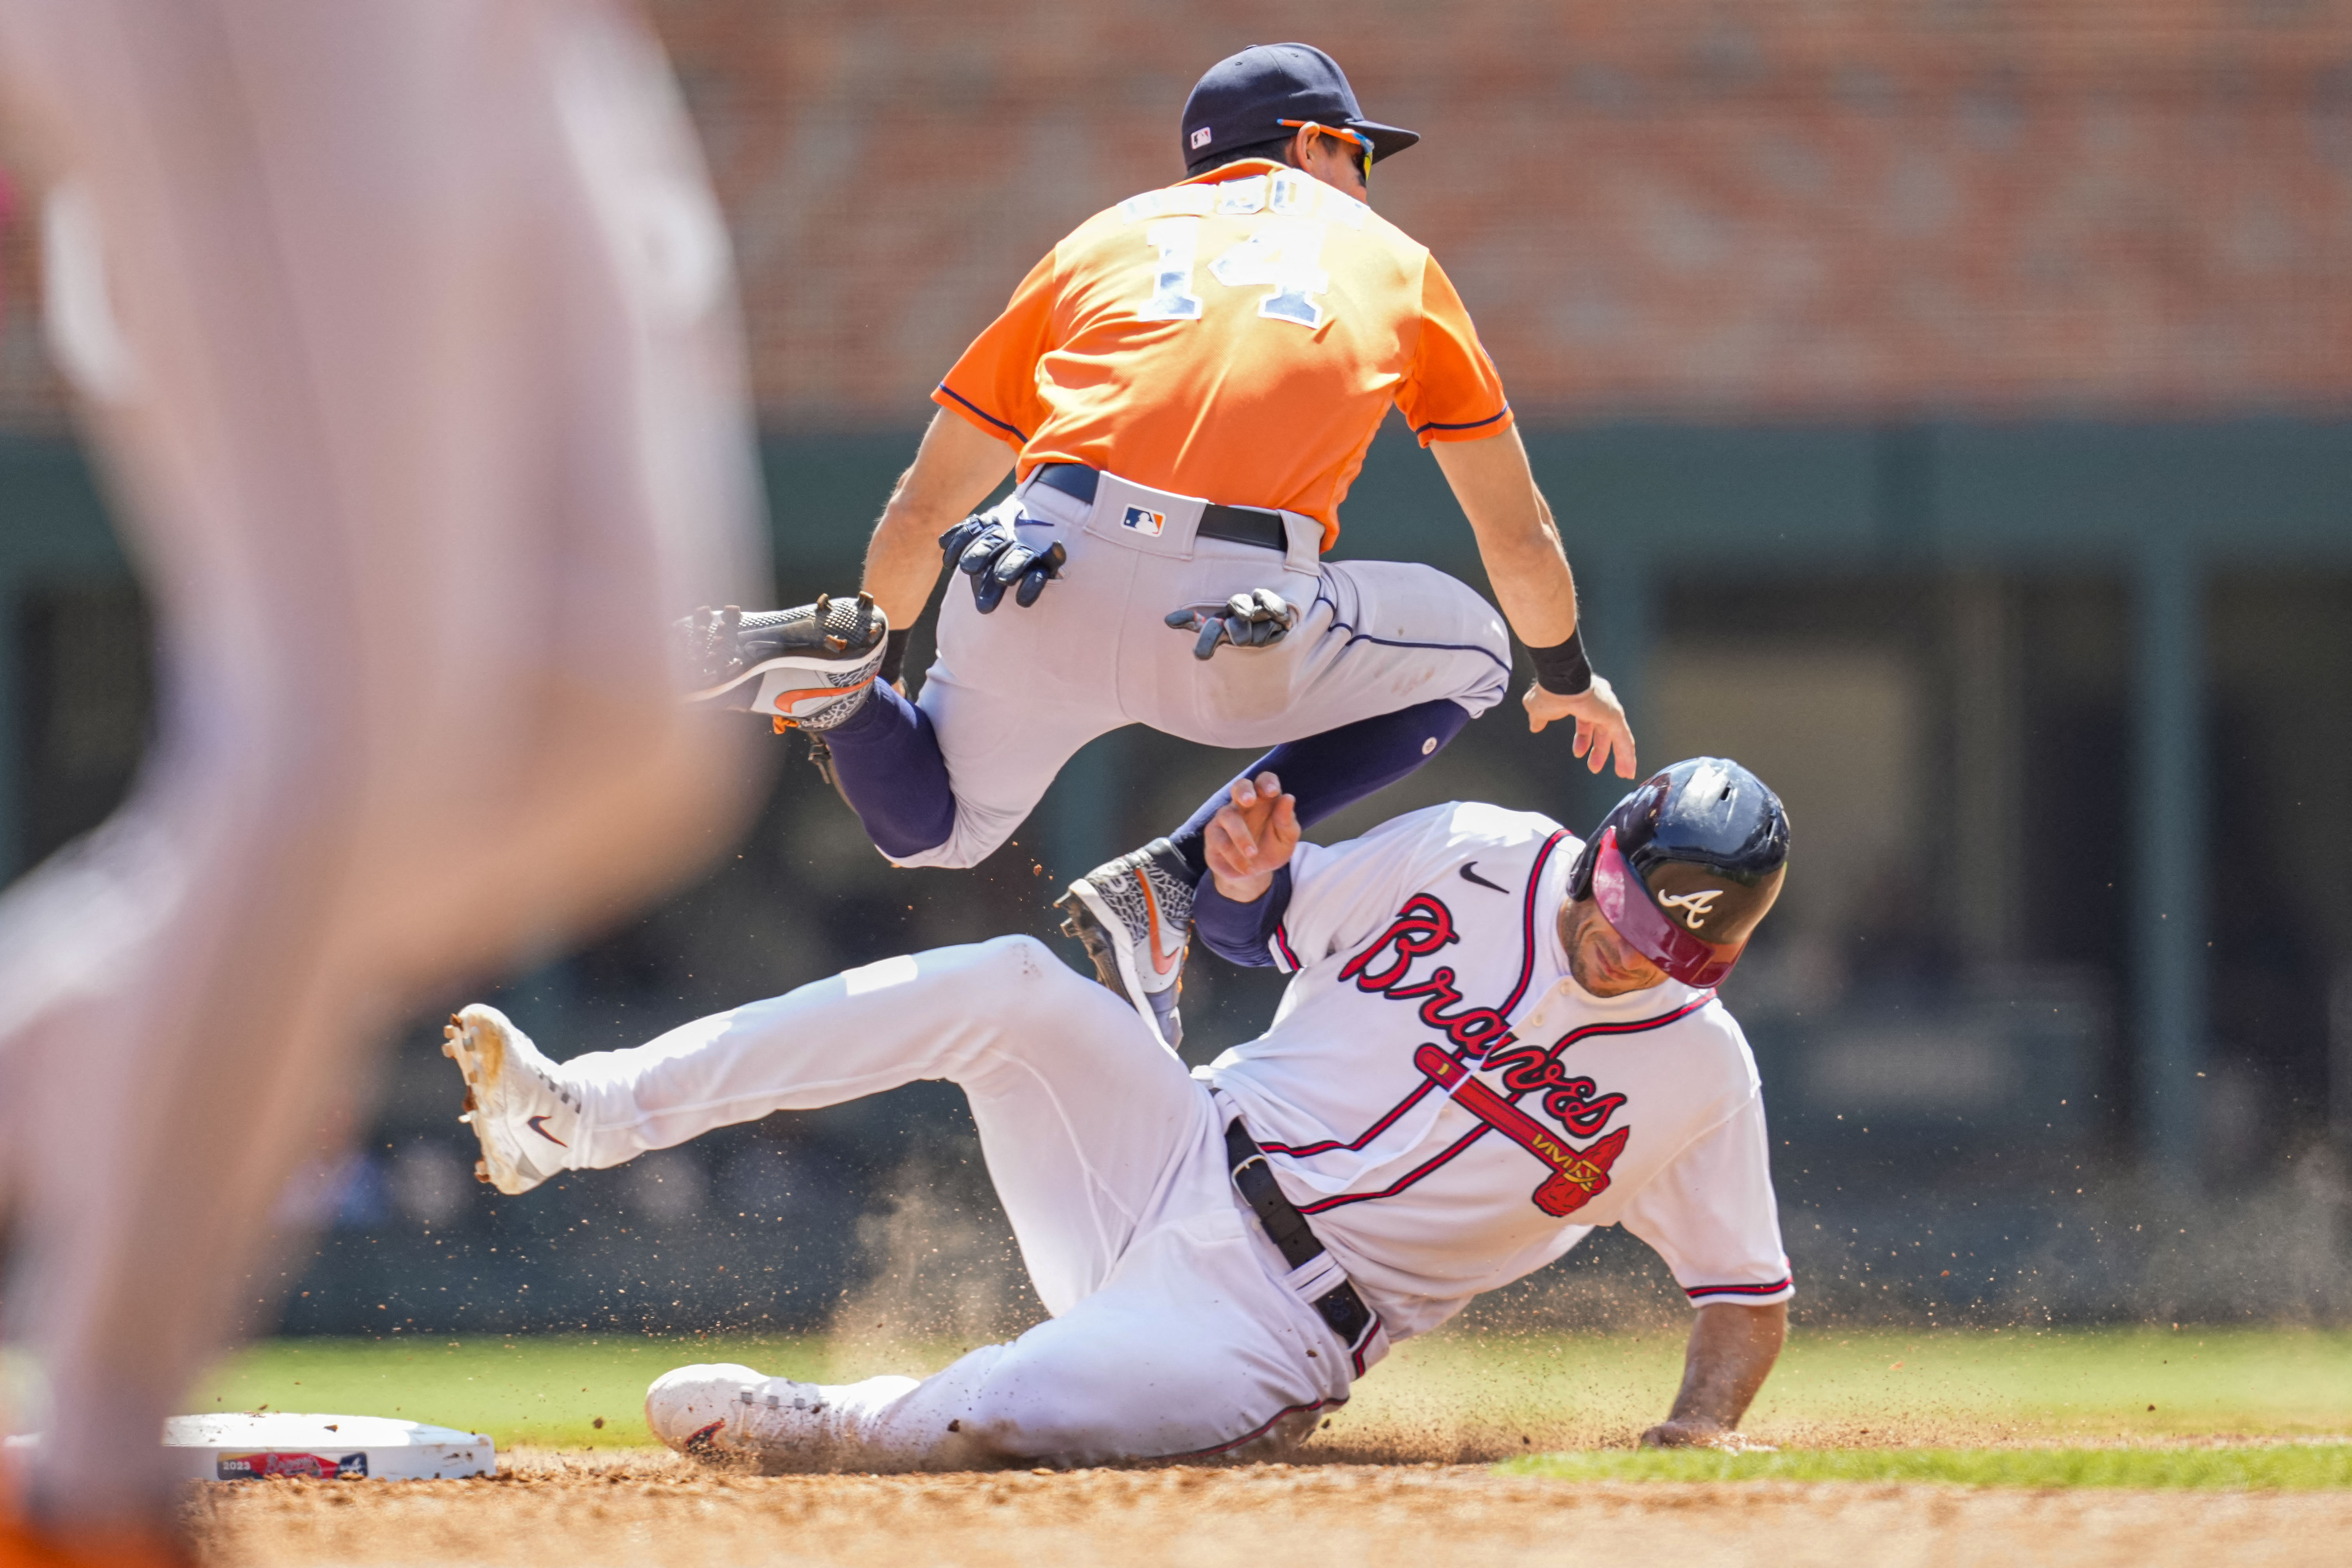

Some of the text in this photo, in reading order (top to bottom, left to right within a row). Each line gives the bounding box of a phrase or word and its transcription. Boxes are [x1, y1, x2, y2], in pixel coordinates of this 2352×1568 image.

[1138, 216, 1329, 329] 14
[1658, 889, 1723, 929] A
[1338, 893, 1627, 1139] Braves
[223, 1461, 251, 1470] 2023
